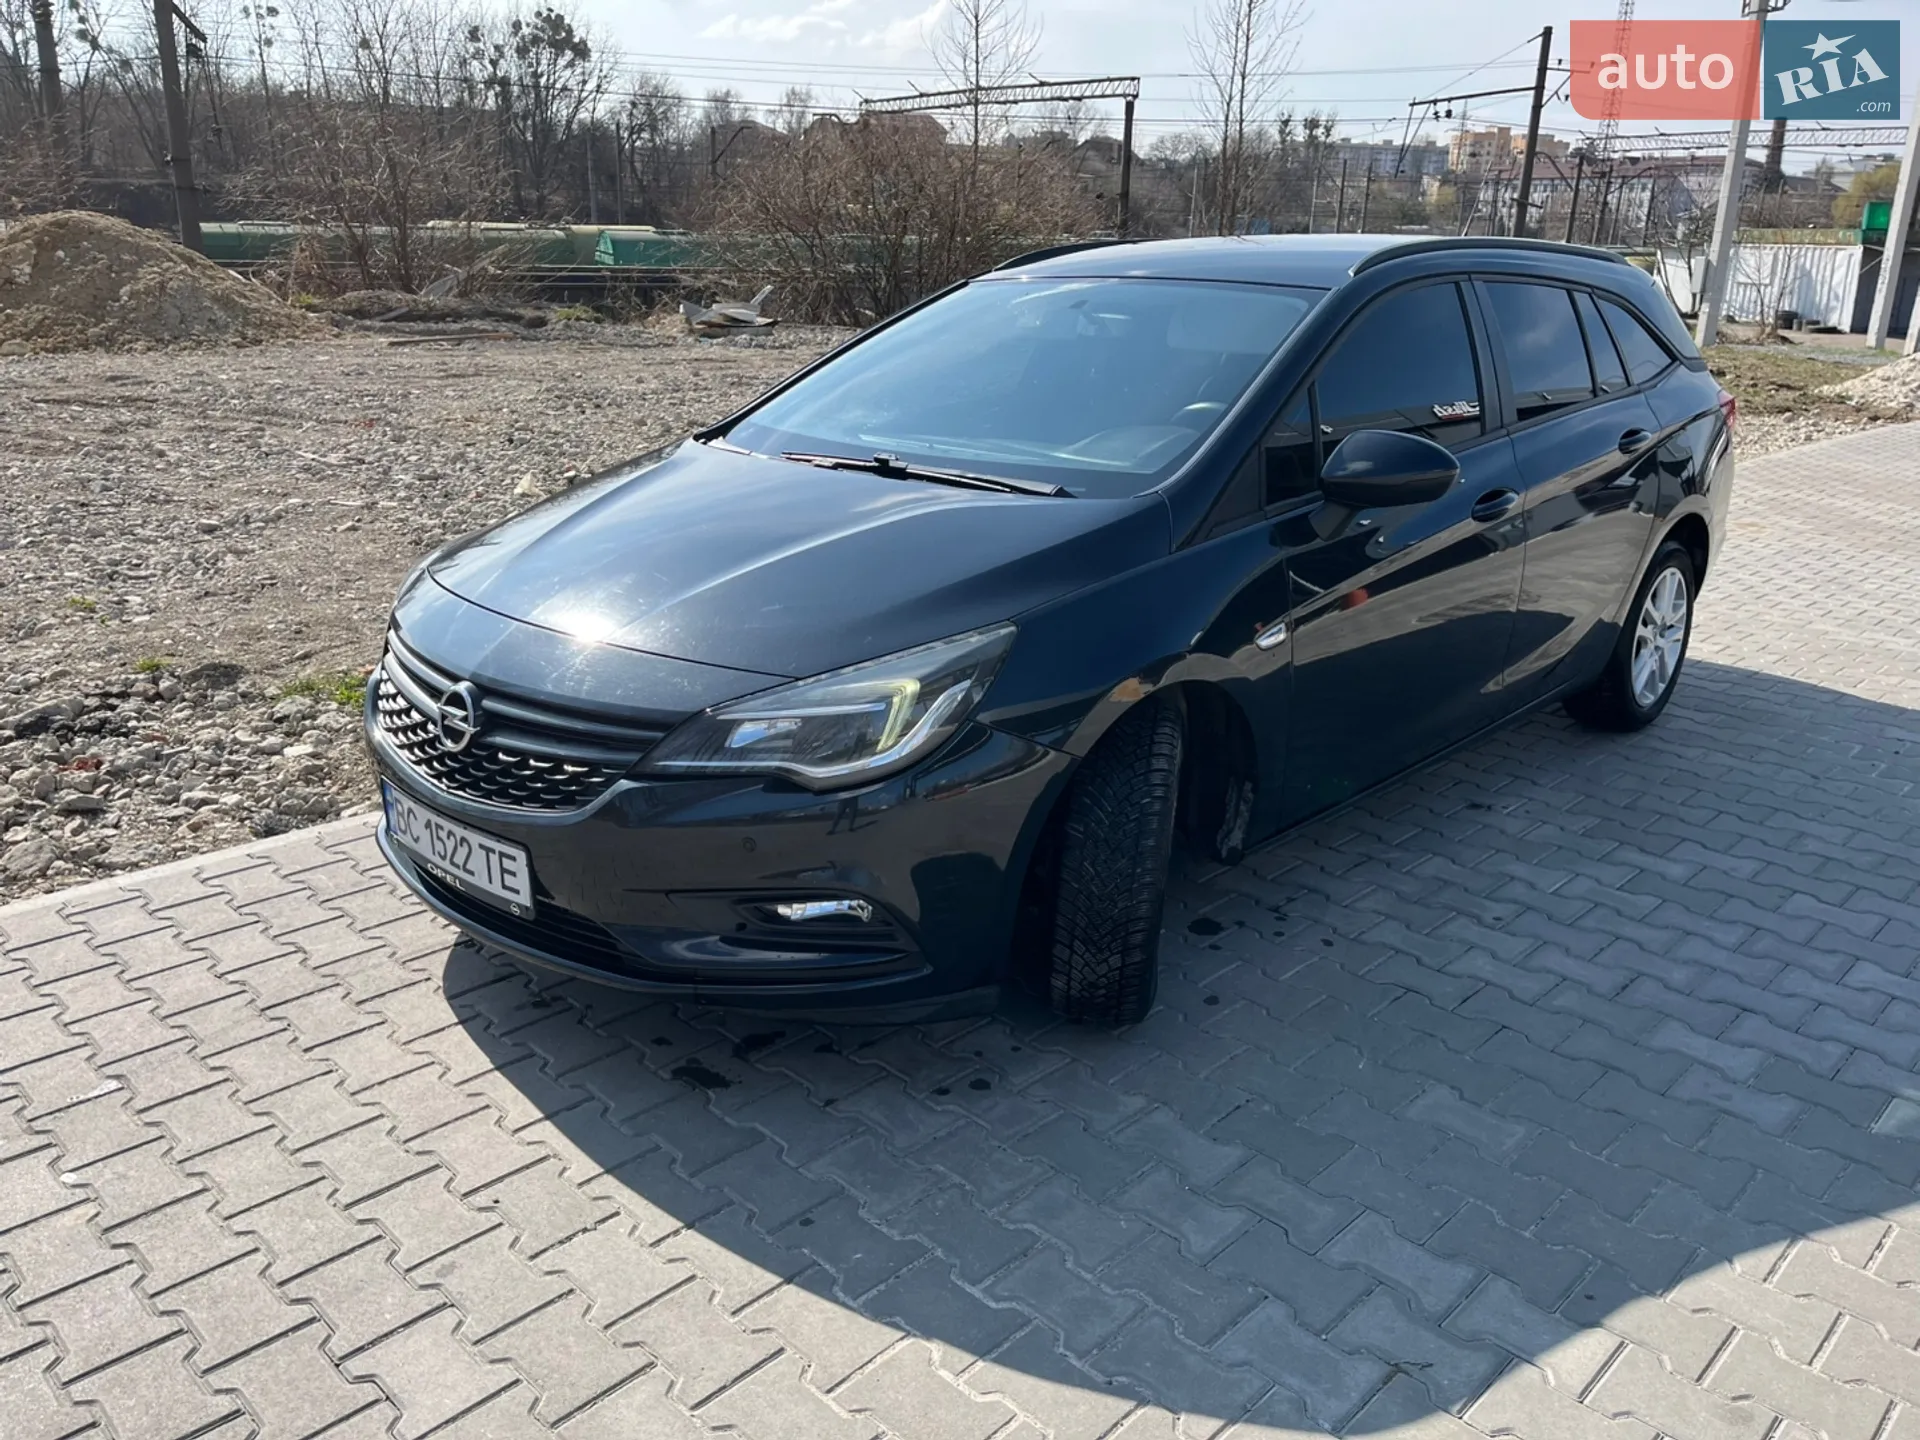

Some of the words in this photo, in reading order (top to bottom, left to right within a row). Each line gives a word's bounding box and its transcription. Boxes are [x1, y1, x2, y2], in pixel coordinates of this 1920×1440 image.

[394, 796, 420, 844] BC
[424, 818, 475, 877] 1522
[478, 843, 521, 895] TE
[427, 862, 466, 891] OPEL
